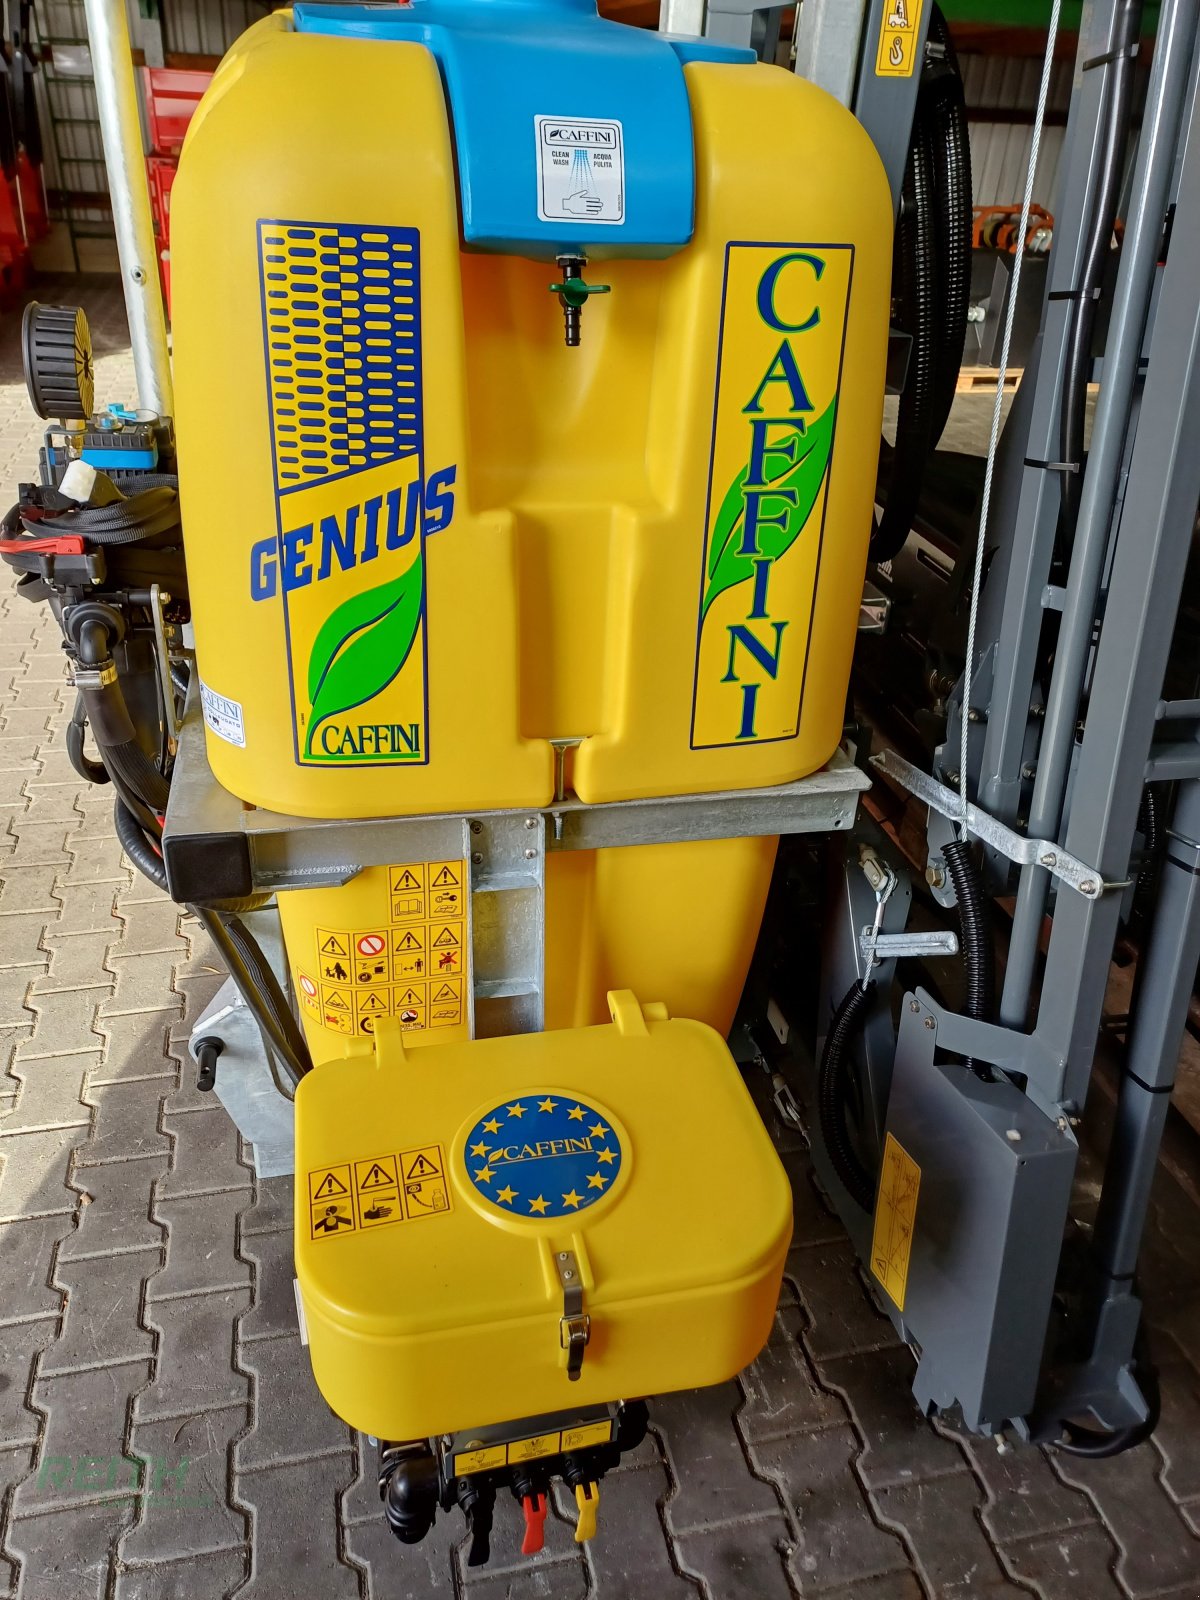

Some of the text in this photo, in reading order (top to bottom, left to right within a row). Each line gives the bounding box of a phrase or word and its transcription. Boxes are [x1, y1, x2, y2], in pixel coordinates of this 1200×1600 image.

[558, 129, 611, 143] CAFFINI
[593, 153, 612, 161] ACQUA
[720, 252, 827, 739] CAFFINI
[251, 464, 457, 602] GENIUS
[321, 723, 421, 755] CAFFINI
[503, 1136, 593, 1161] CAFFINI
